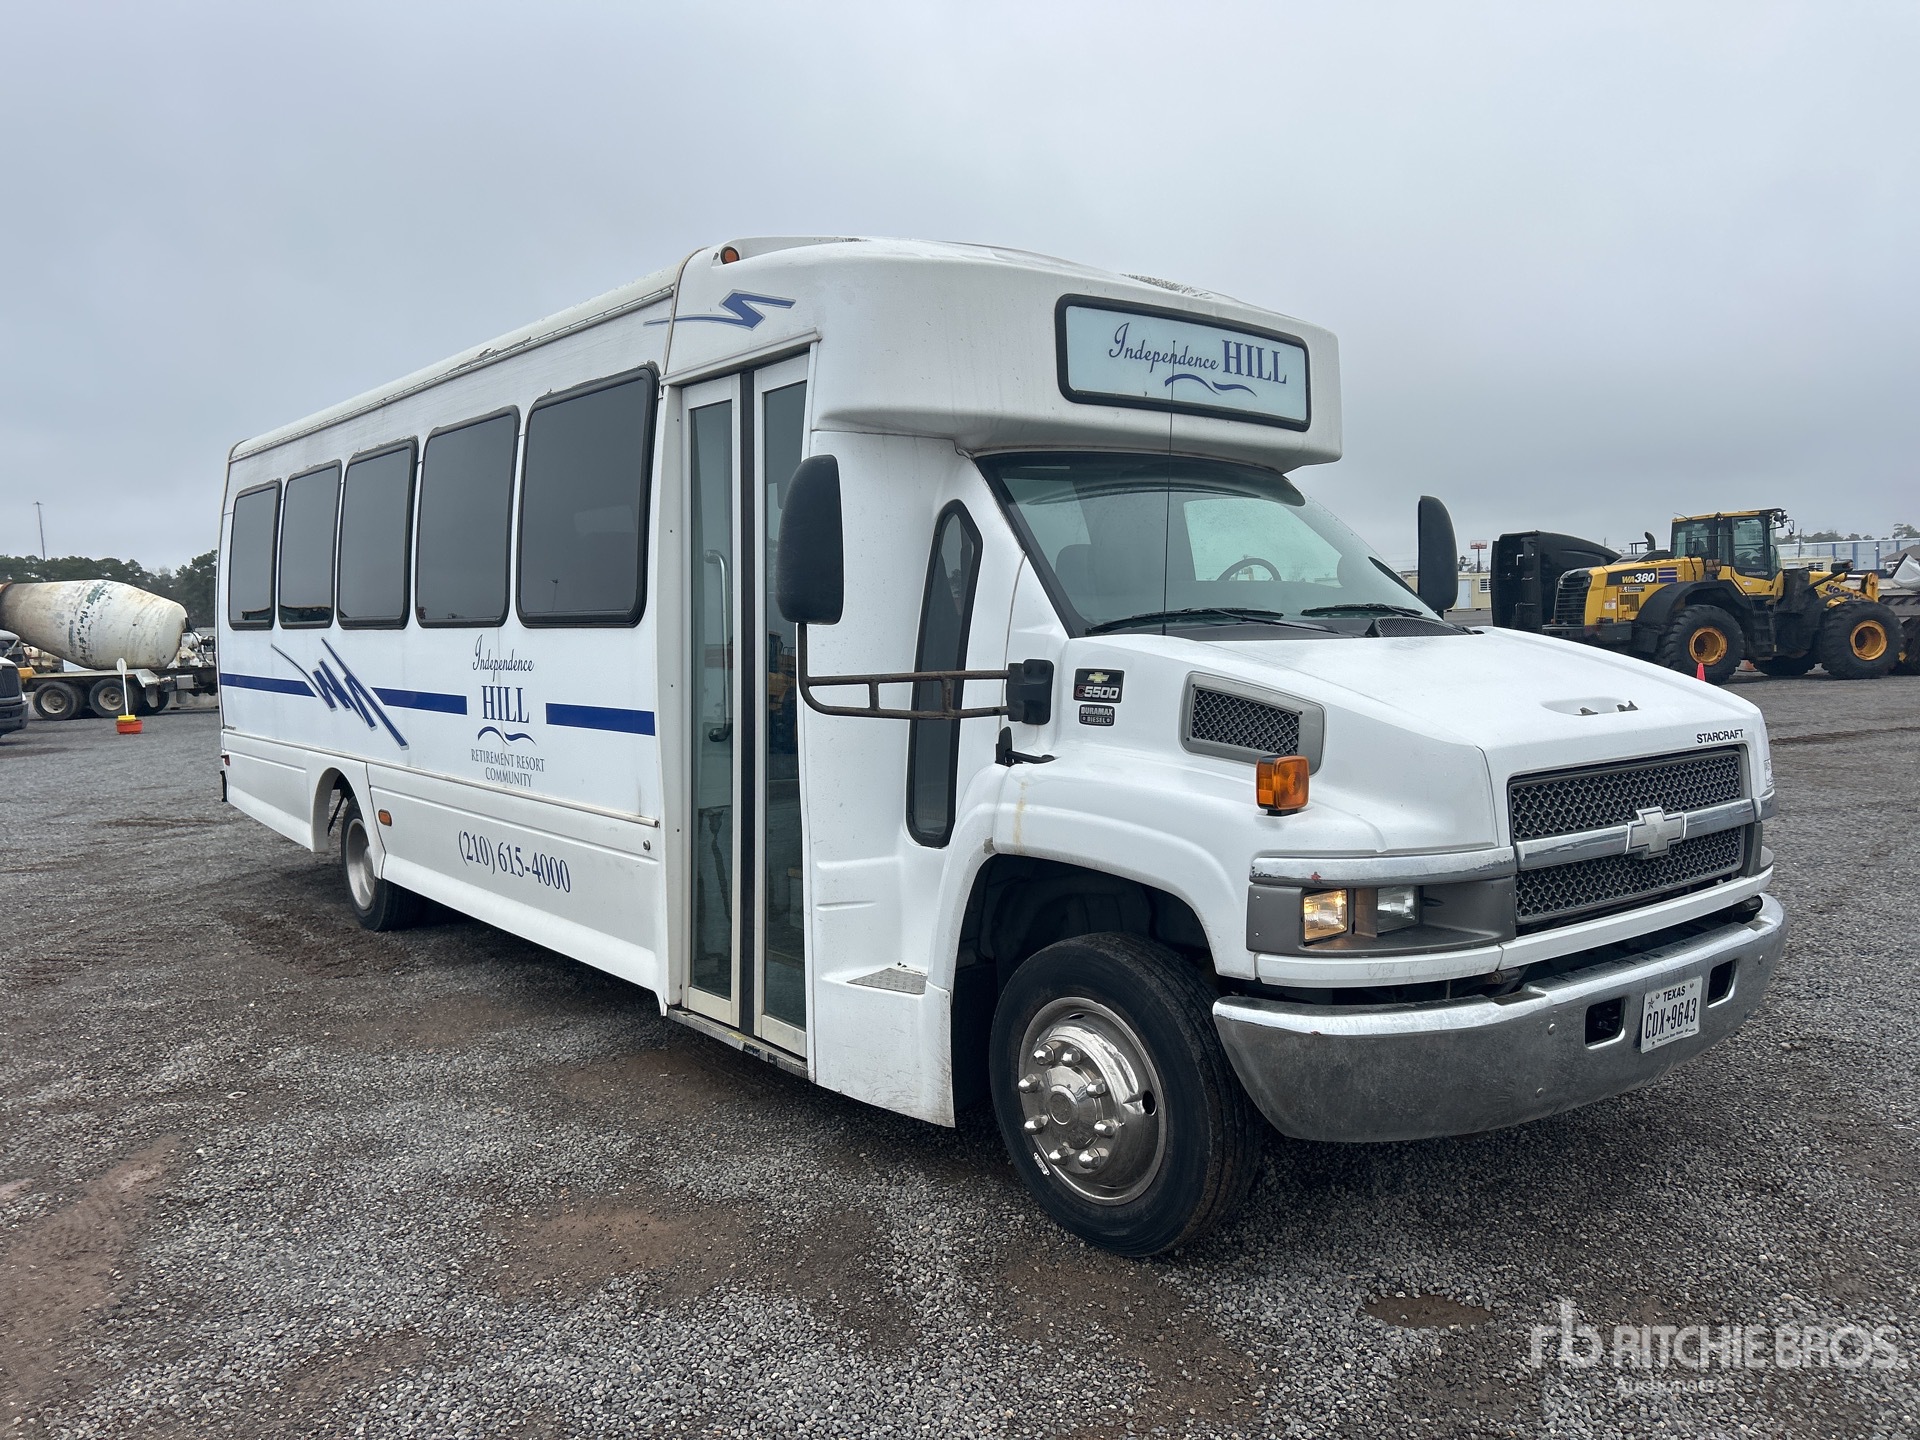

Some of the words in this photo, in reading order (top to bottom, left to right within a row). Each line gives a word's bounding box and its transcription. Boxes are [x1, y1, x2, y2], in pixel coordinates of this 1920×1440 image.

[1108, 322, 1219, 373] Independence
[1222, 340, 1287, 384] HILL
[473, 634, 534, 682] Independence
[481, 685, 529, 723] HILL
[1081, 706, 1113, 716] DURAMAX
[1696, 729, 1743, 743] STARCRAFT
[471, 749, 514, 768] RETIREMENT
[516, 756, 545, 772] RESORT
[485, 767, 532, 787] COMMUNITY
[459, 830, 495, 874] (210)
[498, 842, 570, 893] 615-4000
[1663, 986, 1686, 1002] TEXAS
